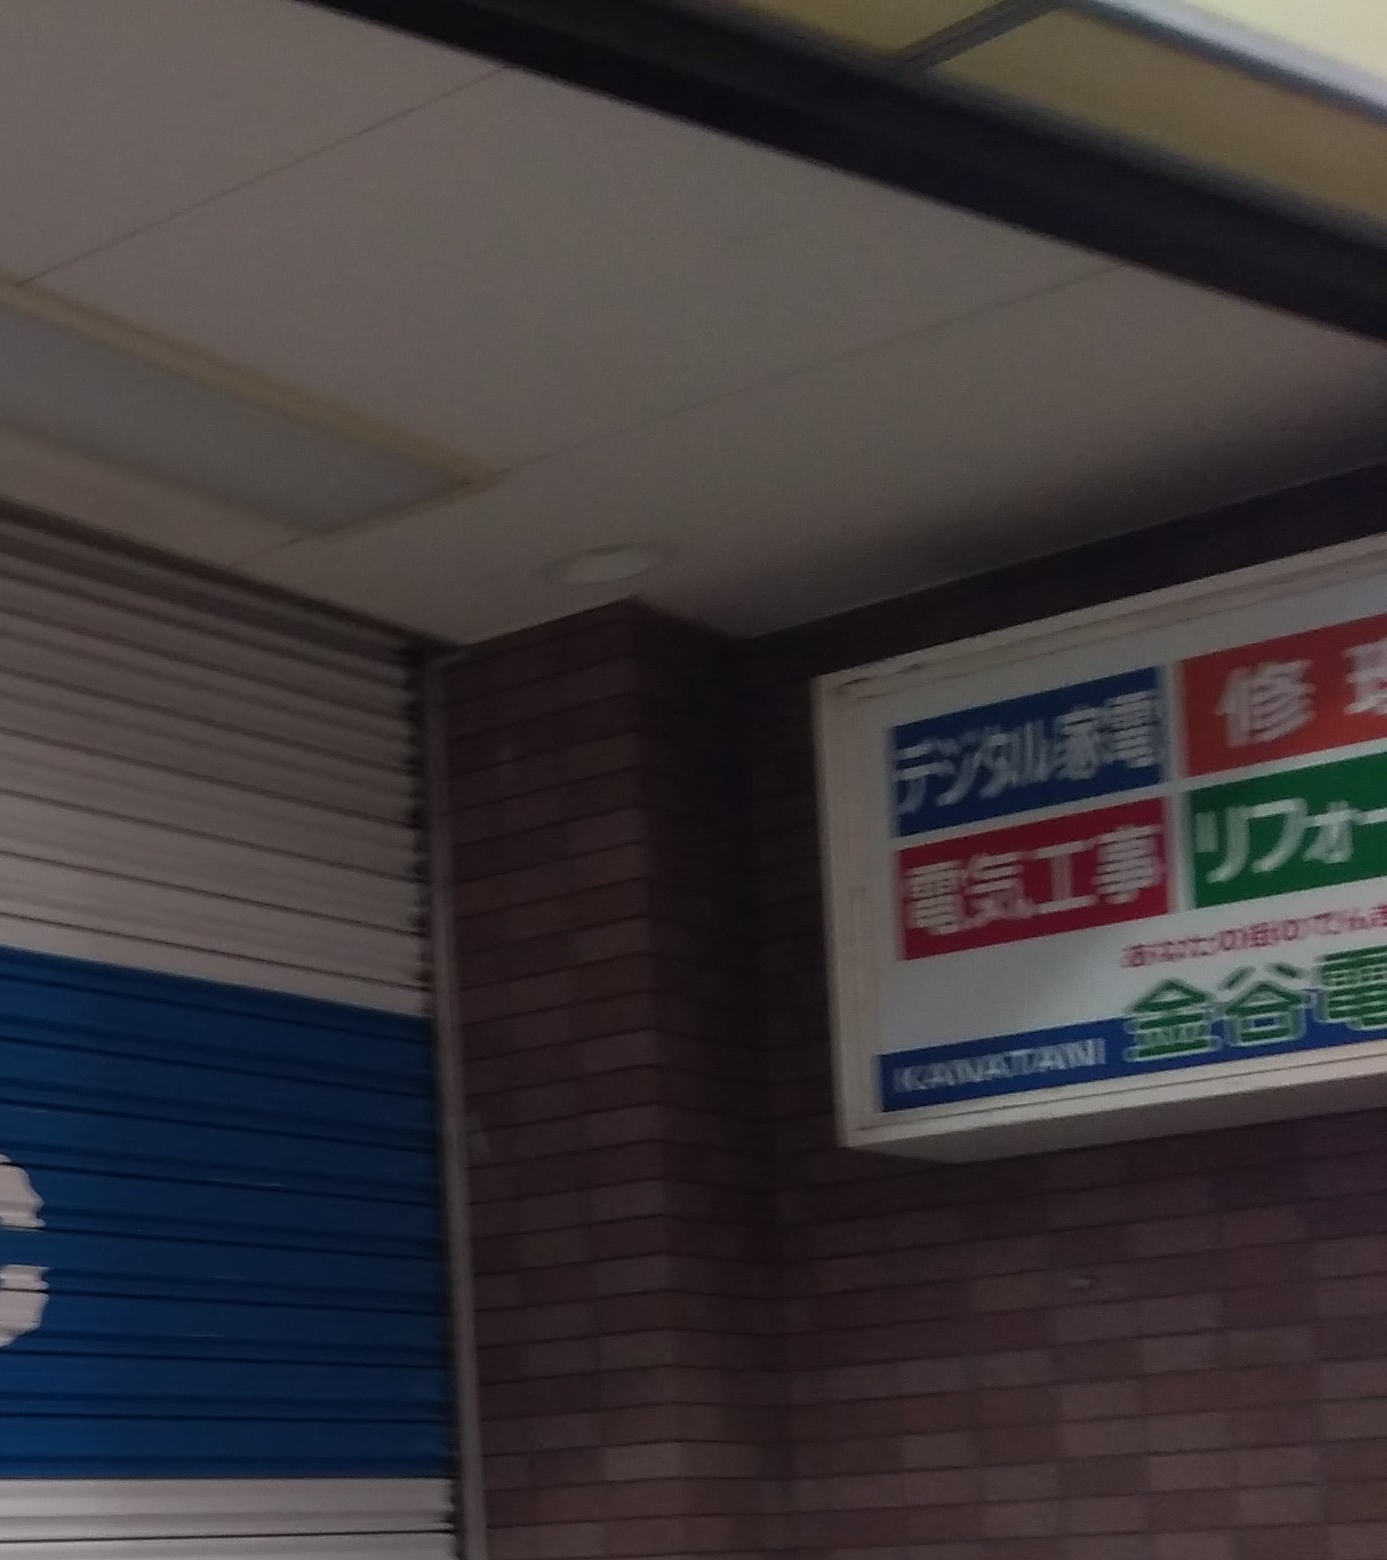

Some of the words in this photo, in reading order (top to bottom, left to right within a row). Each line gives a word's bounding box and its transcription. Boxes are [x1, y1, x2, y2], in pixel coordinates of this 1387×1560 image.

[893, 690, 1163, 816] デジタル家電
[903, 823, 1164, 936] 電気工事
